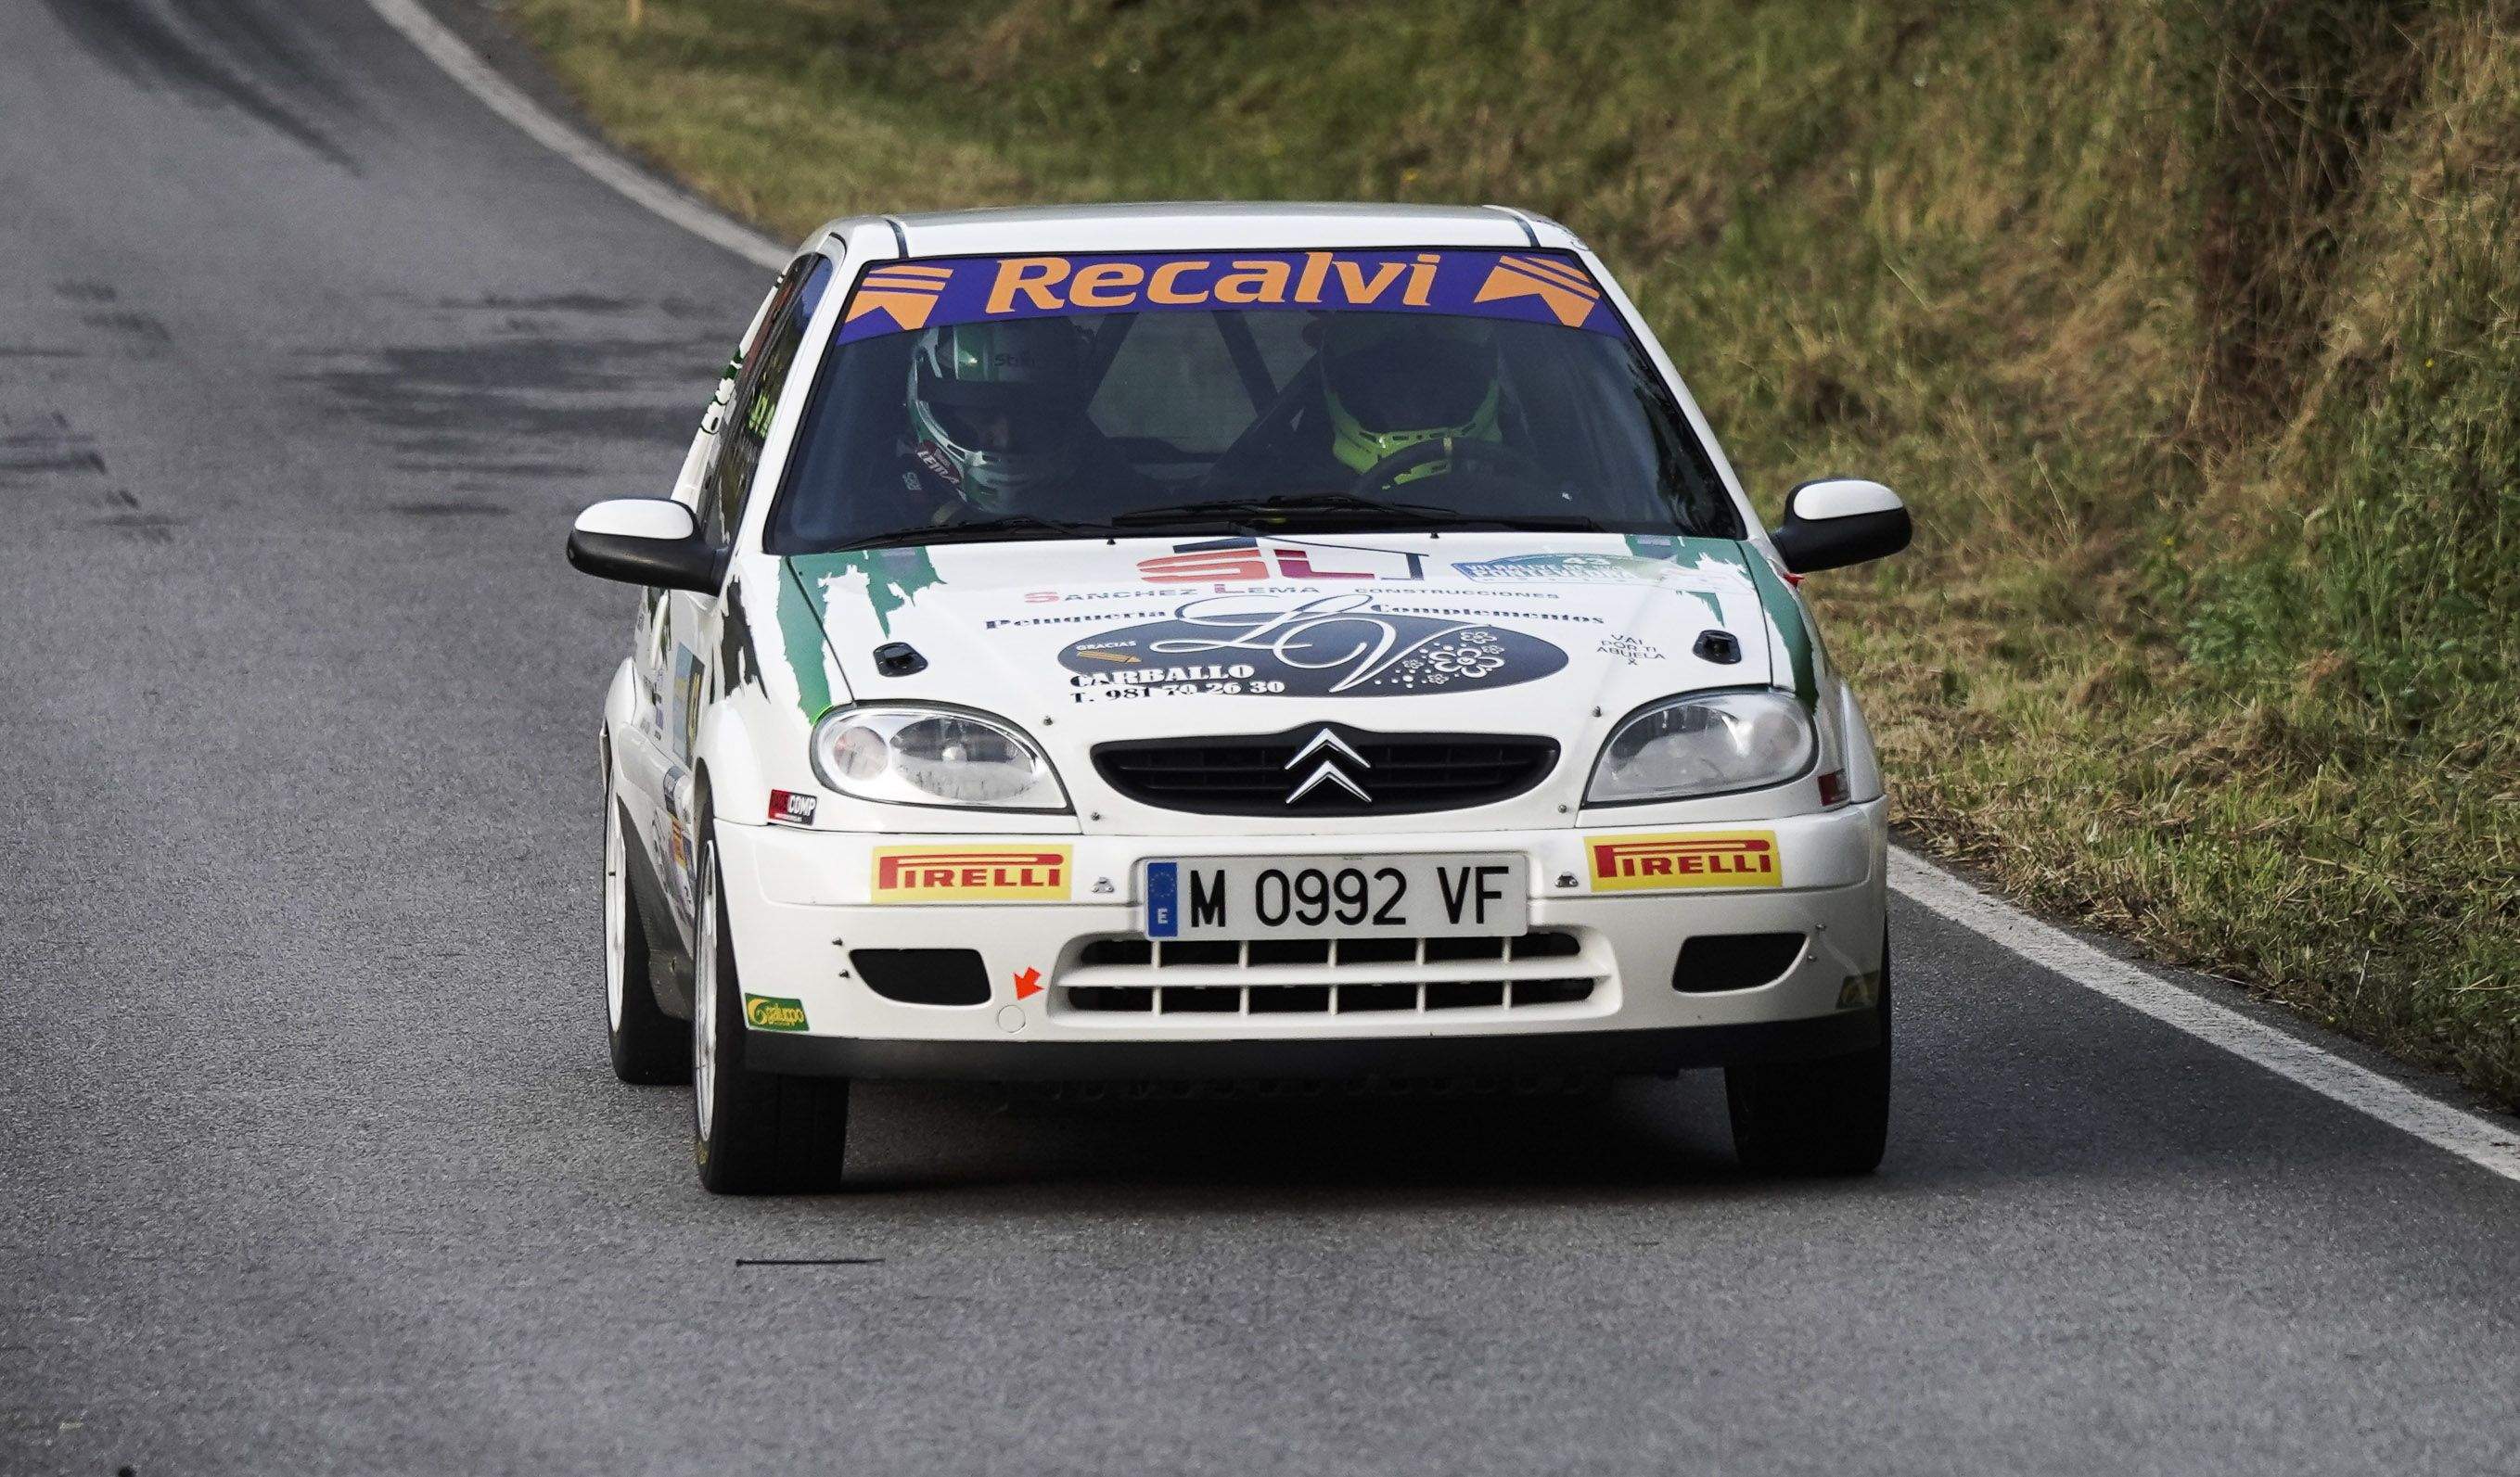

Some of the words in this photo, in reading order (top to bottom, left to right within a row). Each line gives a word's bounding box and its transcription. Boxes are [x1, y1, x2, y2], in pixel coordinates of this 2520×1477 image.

[985, 251, 1441, 313] Recalvi
[1023, 589, 1198, 604] SANCHEZ
[1213, 583, 1322, 594] LEMA
[1354, 589, 1561, 599] CONSTRUCCIONES
[1371, 603, 1605, 624] Complementos
[1075, 640, 1137, 651] GRACIAS
[1069, 664, 1256, 688] CARBALLO
[1070, 692, 1095, 704] T.
[1105, 686, 1152, 700] 981
[1205, 681, 1242, 695] 26
[1249, 680, 1286, 694] 30
[787, 795, 816, 817] COMP
[1593, 839, 1771, 878] PIRELLI
[878, 853, 1065, 889] PIRELLI
[1157, 908, 1168, 924] E
[1190, 869, 1226, 927] M
[1255, 867, 1408, 927] 0992
[1437, 866, 1510, 924] VF
